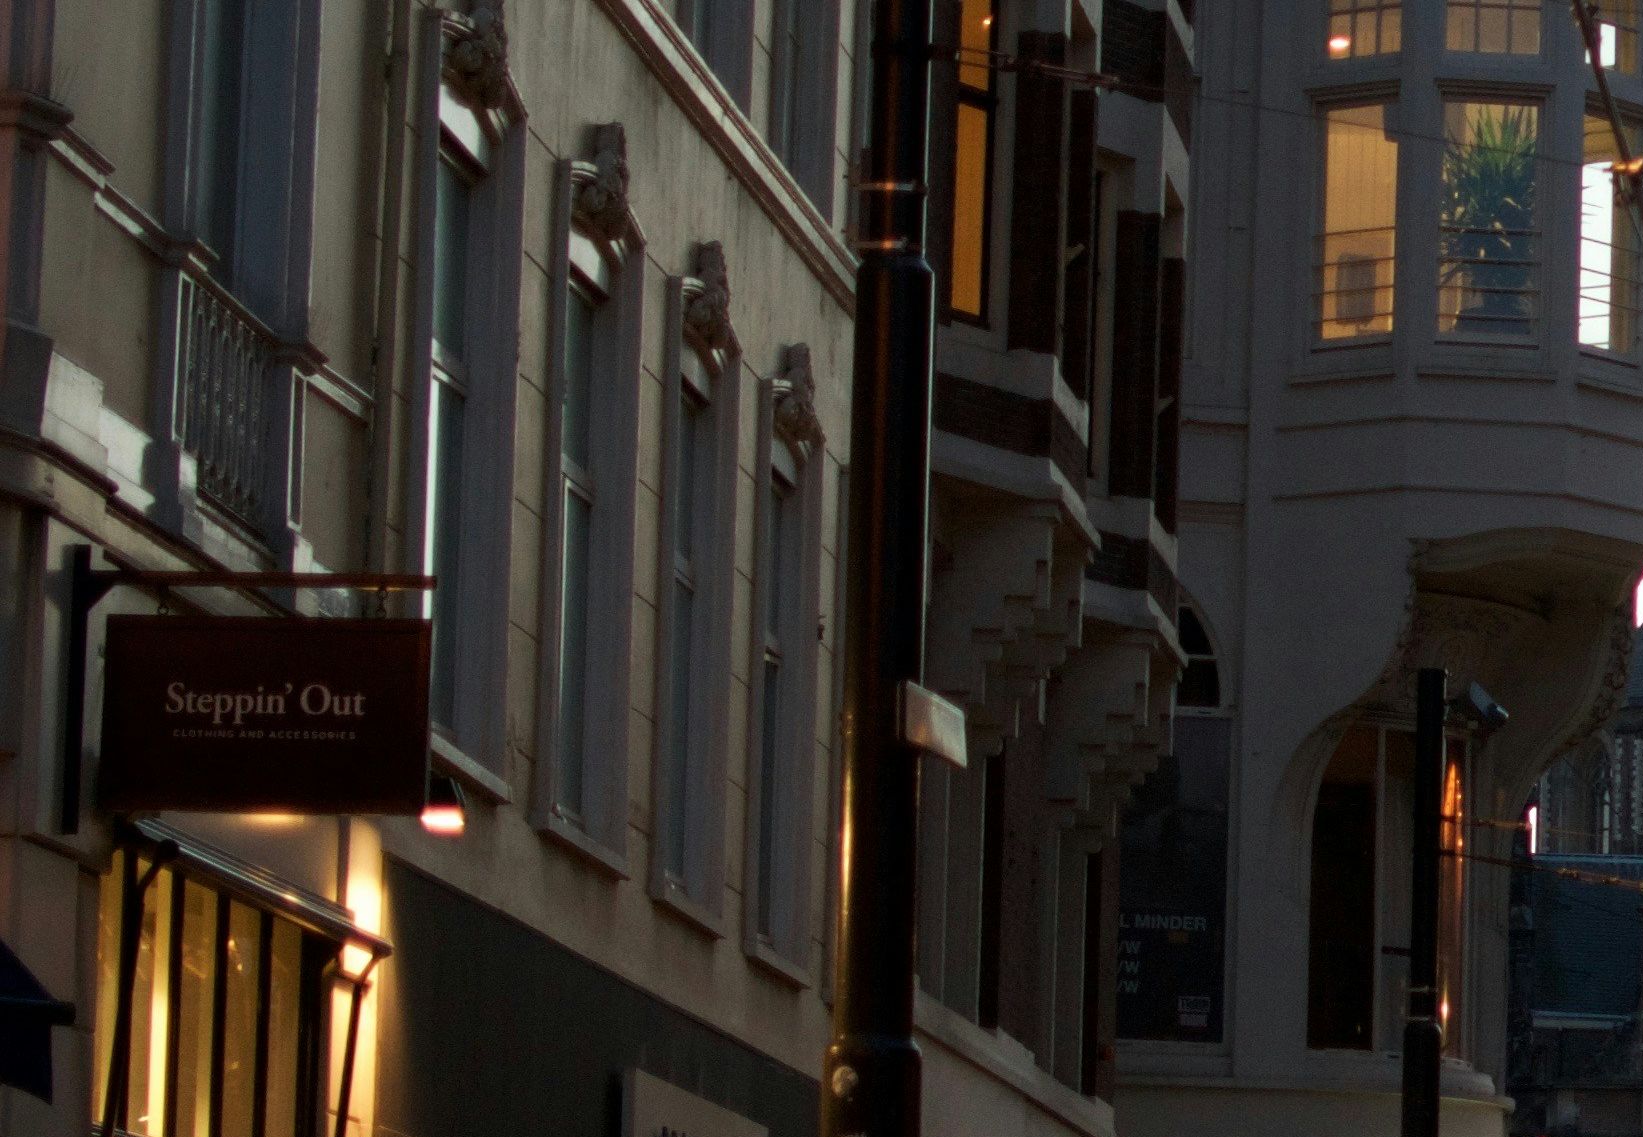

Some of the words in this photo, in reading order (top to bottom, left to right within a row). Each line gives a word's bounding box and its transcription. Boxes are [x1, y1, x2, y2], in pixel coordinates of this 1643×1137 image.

[165, 681, 294, 725] Steppin'
[299, 683, 367, 717] Out
[238, 729, 265, 740] AND
[1134, 912, 1207, 932] MINDER
